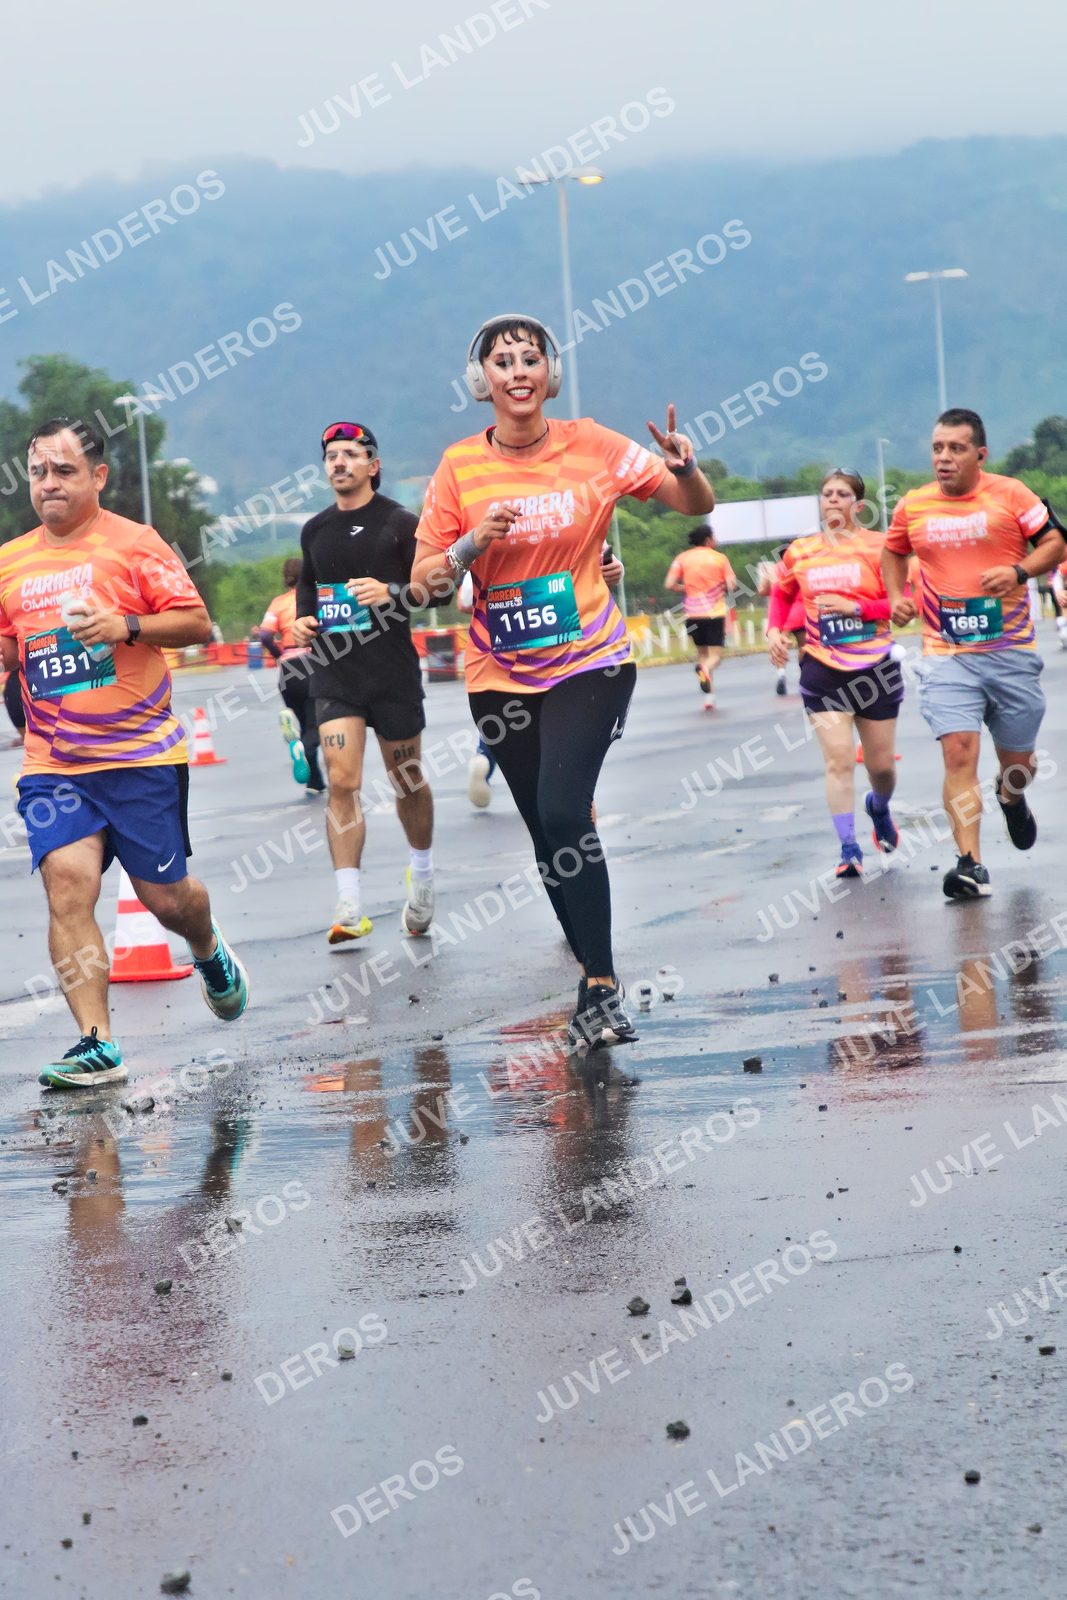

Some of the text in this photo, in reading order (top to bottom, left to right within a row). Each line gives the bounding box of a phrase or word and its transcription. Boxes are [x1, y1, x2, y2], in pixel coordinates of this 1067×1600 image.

[20, 563, 93, 598] CARRERA
[547, 577, 566, 594] 10K
[322, 603, 352, 619] 1570
[500, 604, 557, 632] 1156
[828, 618, 863, 633] 1108
[949, 615, 989, 629] 1683
[28, 634, 57, 651] CARRERA
[38, 652, 91, 679] 1331
